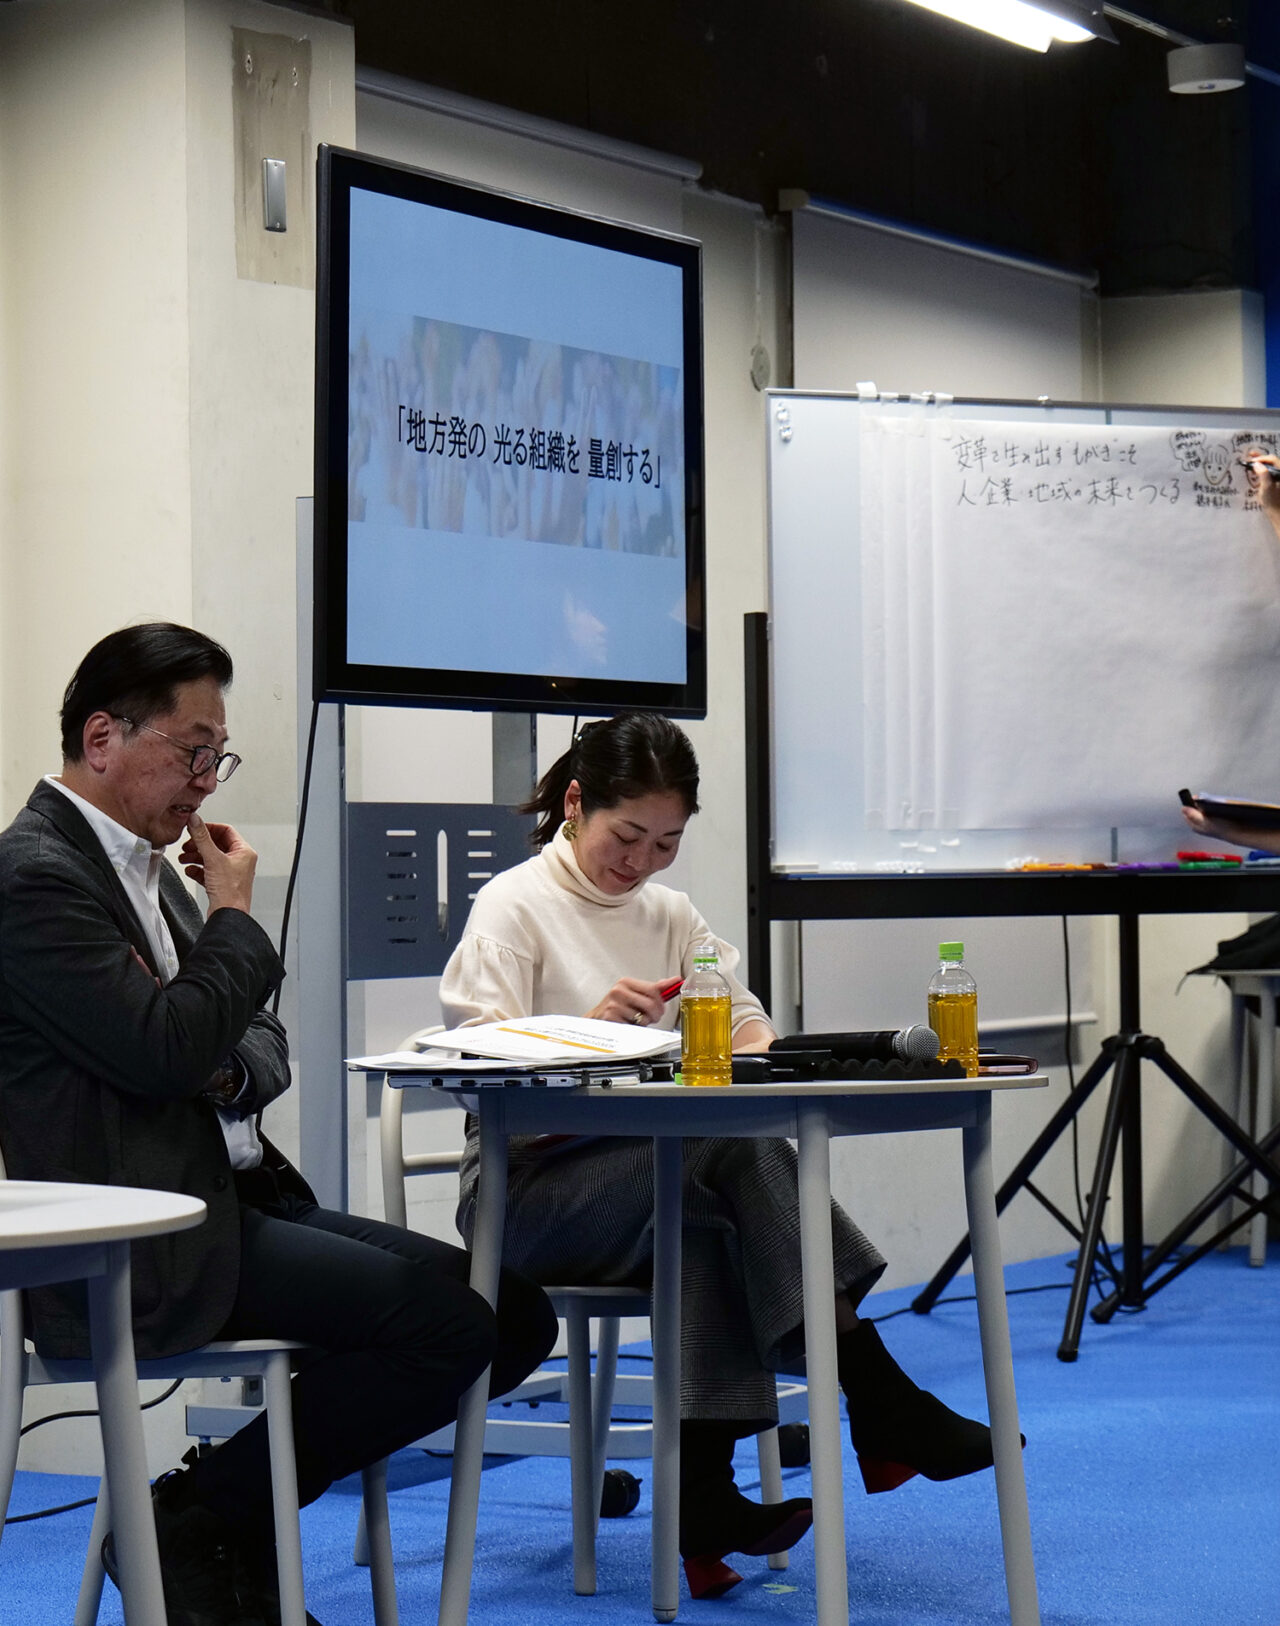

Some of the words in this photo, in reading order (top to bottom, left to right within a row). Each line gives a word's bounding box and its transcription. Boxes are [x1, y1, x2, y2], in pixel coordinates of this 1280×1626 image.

[398, 404, 487, 460] 「地方発の
[493, 423, 581, 474] 光る組織を
[587, 437, 661, 489] 量創する」
